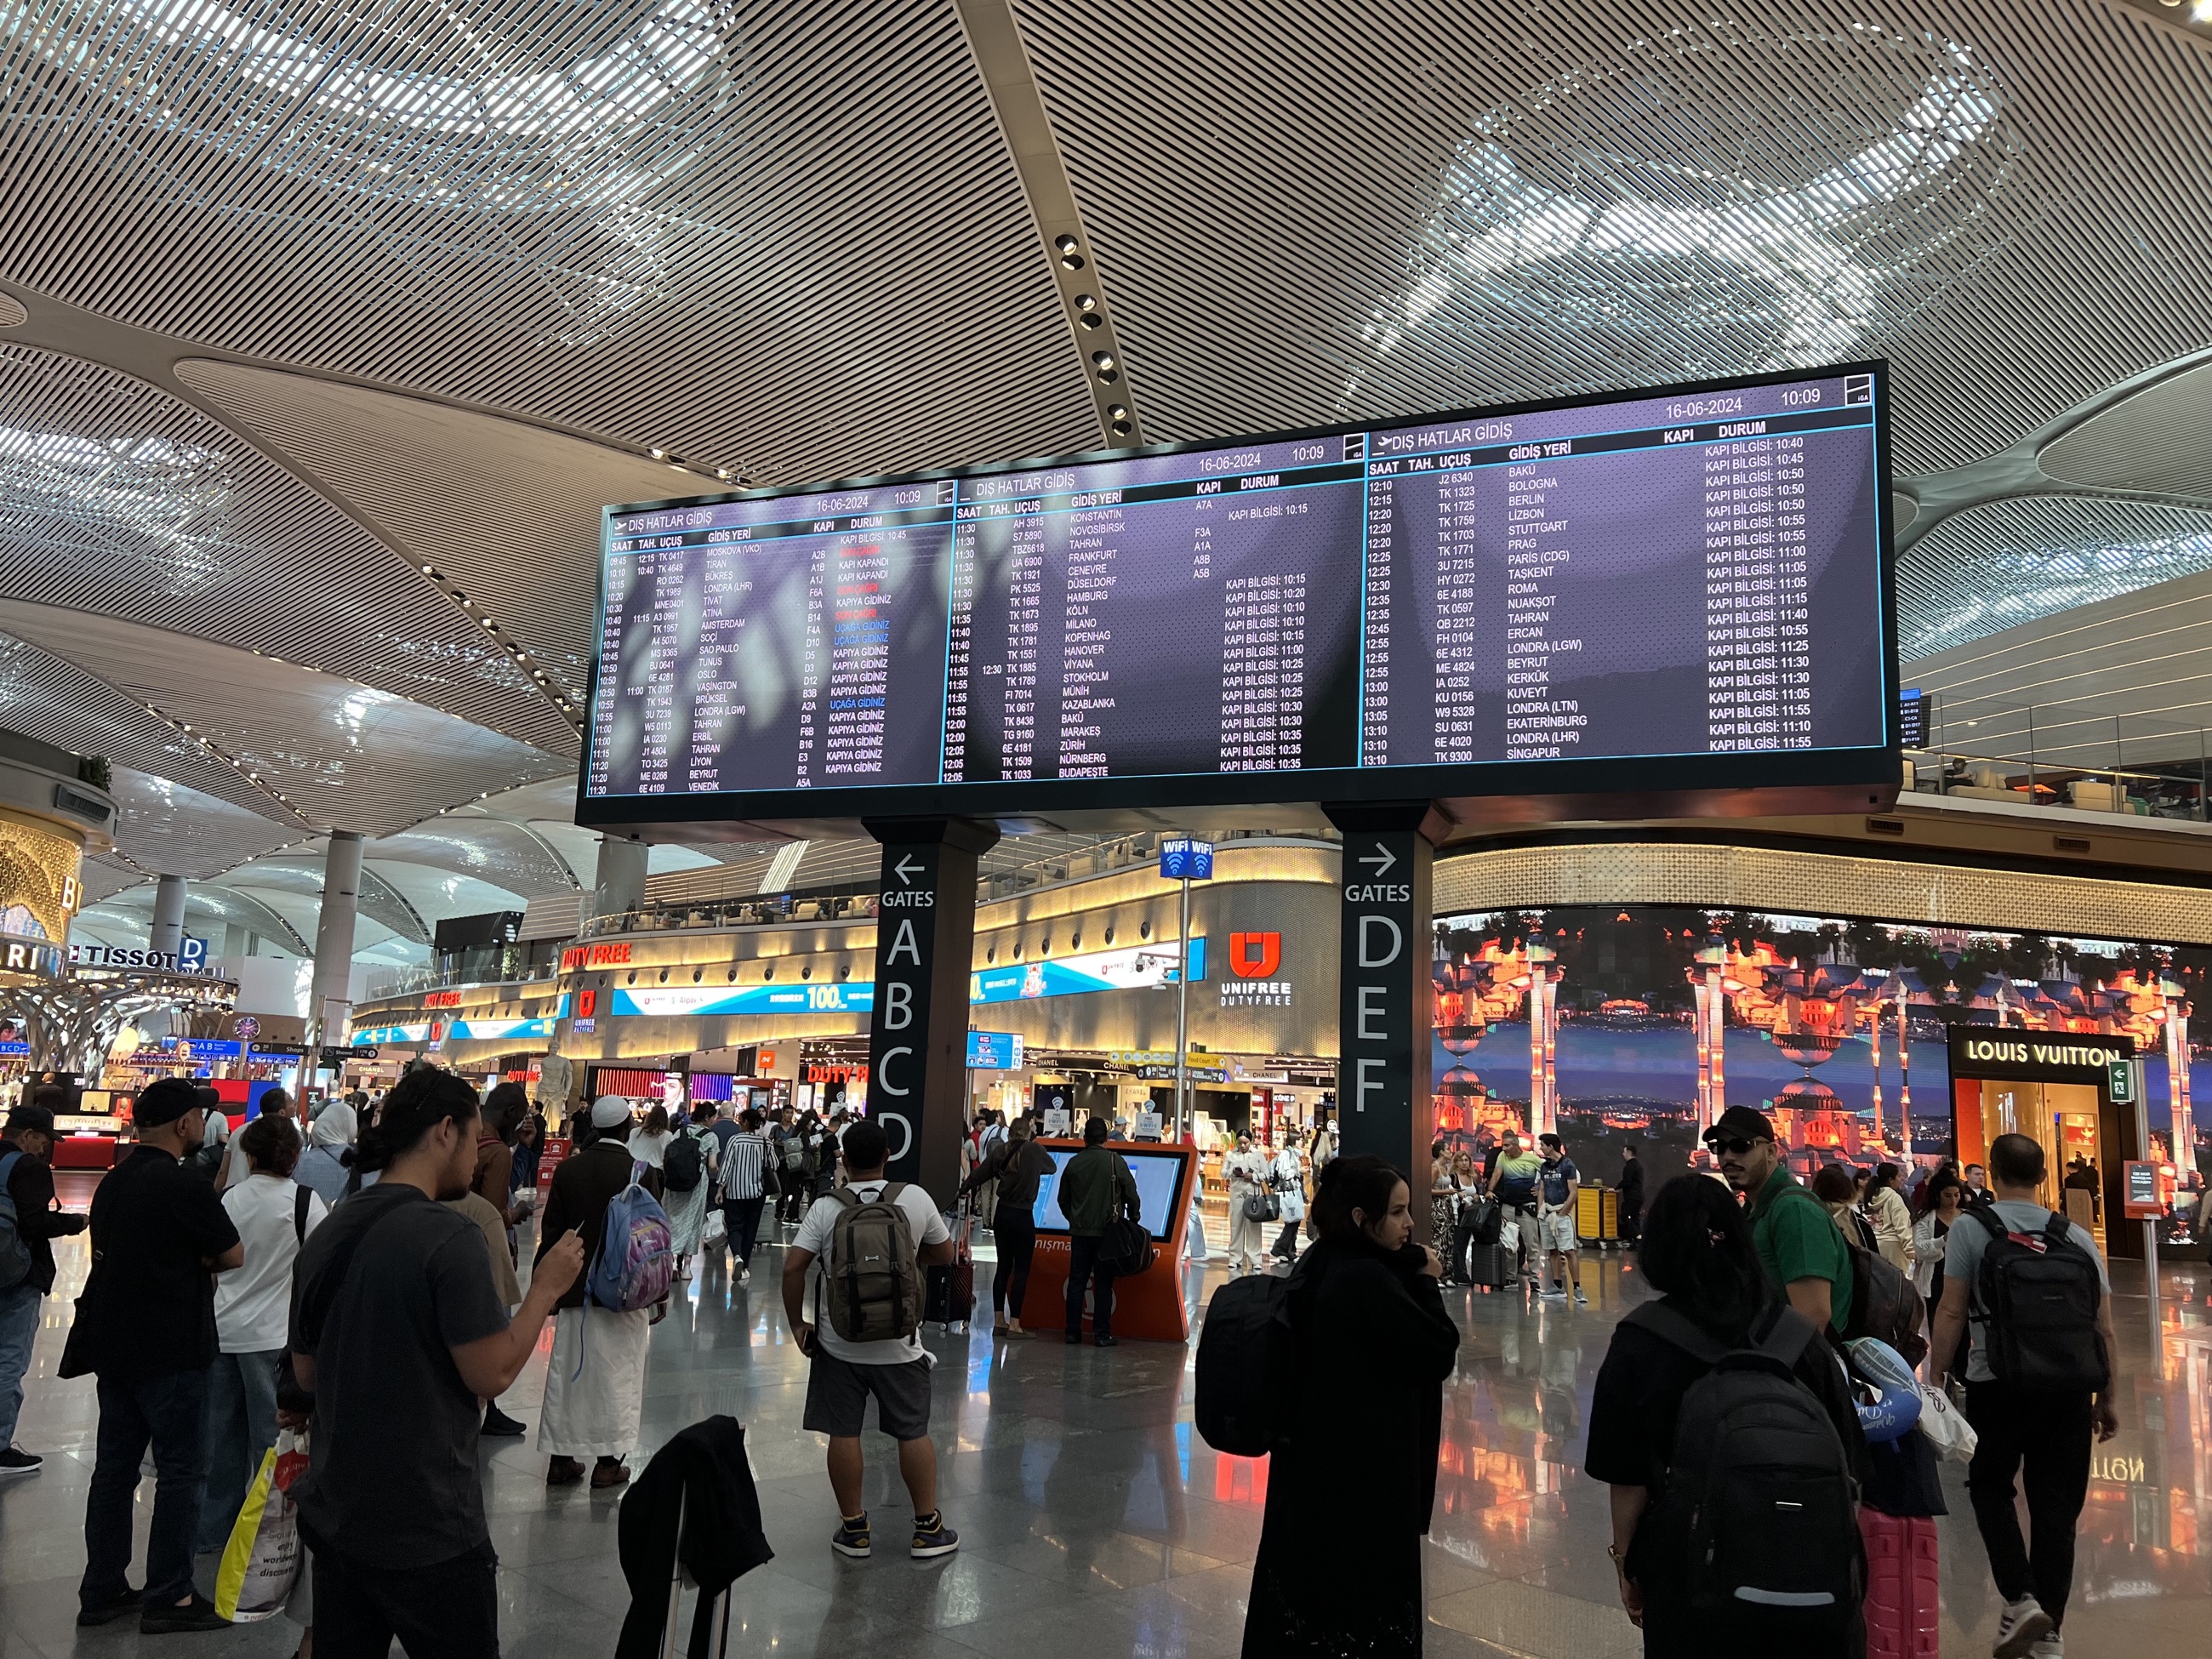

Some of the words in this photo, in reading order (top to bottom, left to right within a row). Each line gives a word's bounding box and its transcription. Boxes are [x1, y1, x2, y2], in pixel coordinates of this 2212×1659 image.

[1666, 396, 1742, 419] 16-06-2024
[1781, 388, 1820, 406] 10:09
[1369, 460, 1399, 476] SAAT
[1407, 457, 1434, 471] TAH.
[1440, 453, 1471, 468] UÇUŞ
[1508, 443, 1541, 460] GİDİŞ
[1542, 439, 1571, 456] YERİ
[1664, 428, 1694, 443] KAPI
[1719, 420, 1765, 437] DURUM
[1392, 434, 1414, 451] DIŞ
[1418, 427, 1471, 447] HATLAR
[1474, 422, 1513, 440] GİDİŞ
[1199, 452, 1261, 471] 16-06-2024
[1292, 445, 1324, 461] 10:09
[977, 482, 995, 497] DIŞ
[997, 476, 1041, 493] HATLAR
[1044, 471, 1075, 488] GİDİŞ
[1369, 494, 1392, 508] 12:15
[1439, 487, 1451, 499] TK
[1453, 485, 1474, 497] 1323
[1508, 476, 1558, 492] BOLOGNA
[1705, 459, 1730, 472] KAPI
[1732, 453, 1773, 470] BİLGİSİ:
[1776, 452, 1804, 465] 10:45
[815, 493, 868, 512] 16-06-2024
[894, 490, 921, 504] 10:09
[957, 505, 982, 518] SAAT
[989, 504, 1010, 516] TAH.
[1014, 500, 1040, 513] UÇUŞ
[1071, 493, 1097, 507] GİDİŞ
[1098, 489, 1121, 505] YERİ
[1196, 481, 1221, 494] KAPI
[1240, 474, 1279, 489] DURUM
[611, 540, 633, 551] SAAT
[638, 538, 656, 550] TAH.
[659, 535, 682, 548] UÇUŞ
[708, 530, 730, 543] GİDİŞ
[732, 527, 751, 540] YERİ
[813, 521, 834, 533] KAPI
[850, 516, 882, 528] DURUM
[628, 518, 644, 533] DIŞ
[646, 514, 683, 529] HATLAR
[686, 510, 712, 526] GİDİŞ
[1508, 520, 1568, 535] STUTTGART
[601, 663, 618, 673] 10:50
[650, 661, 658, 671] BJ
[658, 660, 674, 670] 0641
[698, 656, 722, 667] TUNUS
[805, 650, 815, 660] D5
[833, 647, 860, 658] KAPIYA
[861, 644, 888, 656] GİDİNİZ
[949, 666, 968, 676] 11:55
[982, 664, 1001, 675] 12:30
[1006, 663, 1018, 673] TK
[1019, 662, 1036, 672] 1885
[1063, 658, 1094, 670] VİYANA
[1223, 647, 1244, 658] KAPI
[1246, 643, 1279, 658] BİLGİSİ:
[1281, 644, 1303, 654] 11:00
[596, 711, 613, 722] 10:55
[645, 710, 655, 719] 3U
[656, 709, 671, 718] 7239
[694, 706, 723, 716] LONDRA
[724, 705, 745, 715] (LGW)
[801, 701, 816, 710] A2A
[830, 698, 856, 710] UÇAĞA
[858, 698, 885, 707] GİDİNİZ
[1062, 697, 1115, 710] KAZABLANKA
[1364, 725, 1387, 736] 13:10
[1434, 721, 1449, 733] SU
[1451, 721, 1472, 732] 0631
[1507, 715, 1587, 729] EKATERİNBURG
[1709, 707, 1735, 719] KAPI
[1736, 703, 1779, 718] BİLGİSİ:
[1782, 704, 1810, 715] 11:55
[1507, 745, 1560, 759] SİNGAPUR
[688, 781, 720, 792] VENEDİK
[1164, 840, 1189, 853] WiFi
[1192, 841, 1212, 855] WiFi
[882, 892, 933, 906] GATES
[1346, 885, 1410, 901] GATES
[184, 939, 202, 958] D
[887, 920, 921, 965] A
[1359, 915, 1401, 966] D
[86, 945, 177, 969] TISSOT
[563, 947, 590, 967] DUTY
[593, 943, 631, 964] FREE
[425, 995, 439, 1007] DUTY
[441, 992, 461, 1006] FREE
[807, 986, 840, 1009] 100
[1221, 995, 1290, 1006] DUTYFREE
[1222, 983, 1291, 994] UNIFREE
[885, 983, 912, 1029] B
[1358, 987, 1387, 1039] E
[1968, 1040, 2028, 1063] LOUIS
[2034, 1046, 2119, 1066] VUITTON
[507, 1070, 525, 1081] DUTY
[808, 1066, 853, 1084] DUTY
[879, 1047, 912, 1095] C
[1103, 1062, 1130, 1072] CHANEL
[1357, 1059, 1385, 1111] F
[885, 1113, 912, 1161] D
